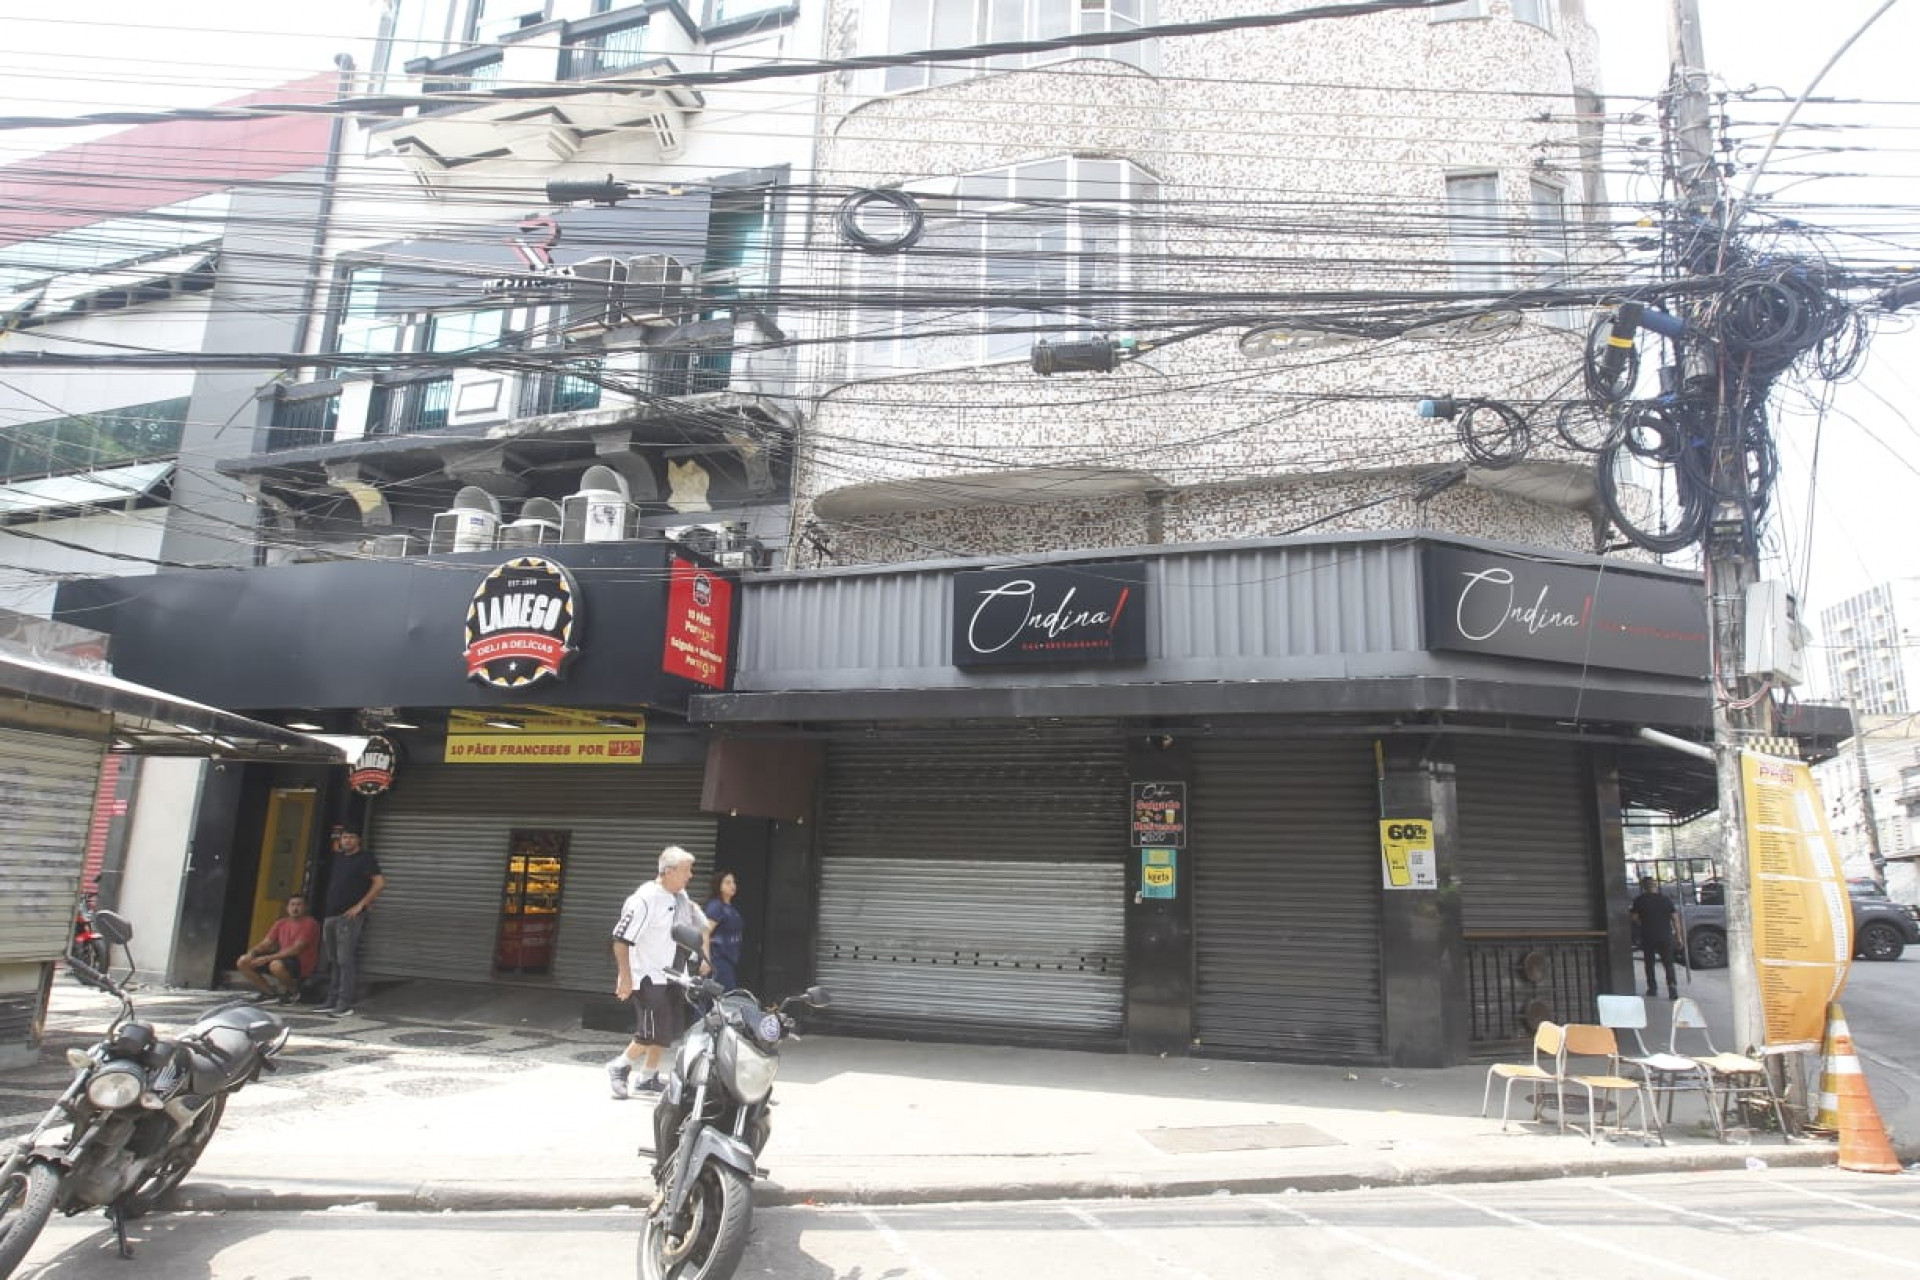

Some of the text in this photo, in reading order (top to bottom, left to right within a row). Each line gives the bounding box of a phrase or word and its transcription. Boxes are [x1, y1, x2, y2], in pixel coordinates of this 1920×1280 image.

[477, 593, 562, 634] LAMEGO
[968, 579, 1131, 653] Ondina!
[477, 644, 500, 656] DELI
[450, 745, 464, 755] 10
[579, 745, 603, 755] POR
